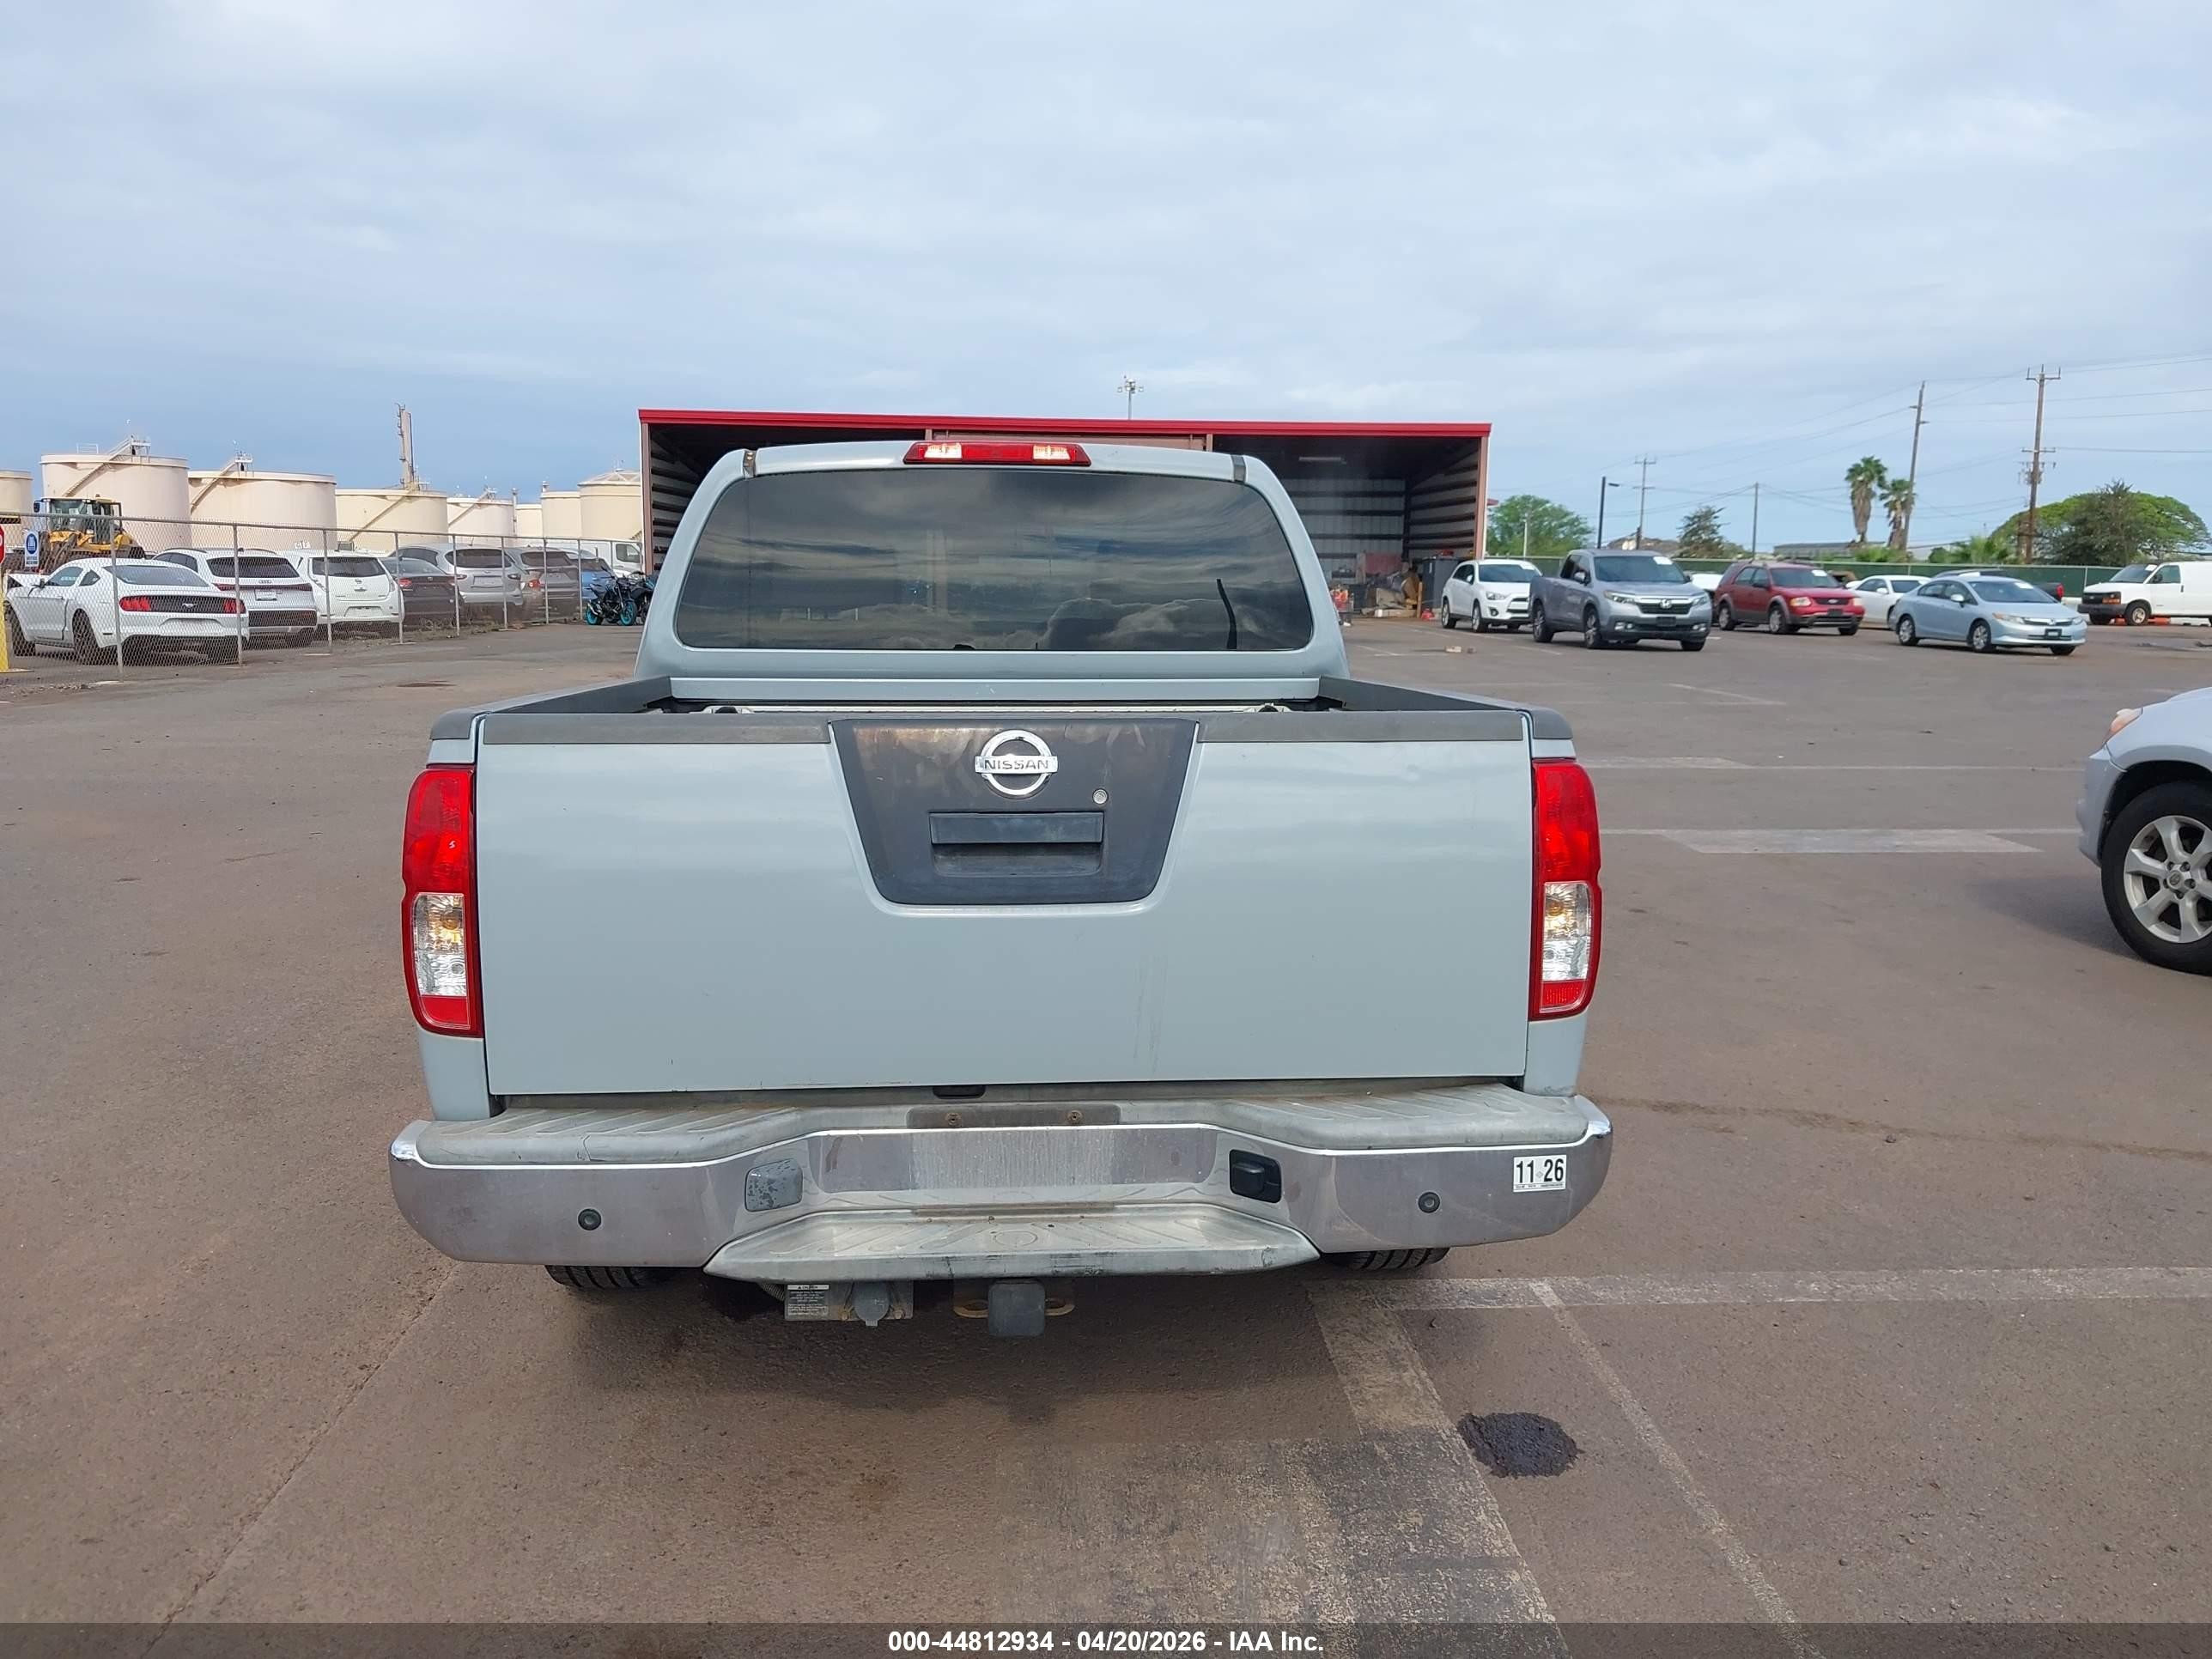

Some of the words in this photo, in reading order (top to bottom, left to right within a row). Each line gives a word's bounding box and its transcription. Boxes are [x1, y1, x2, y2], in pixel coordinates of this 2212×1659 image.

[984, 759, 1048, 770] NISSAN
[1516, 1159, 1534, 1183] 11
[1543, 1158, 1565, 1182] 26
